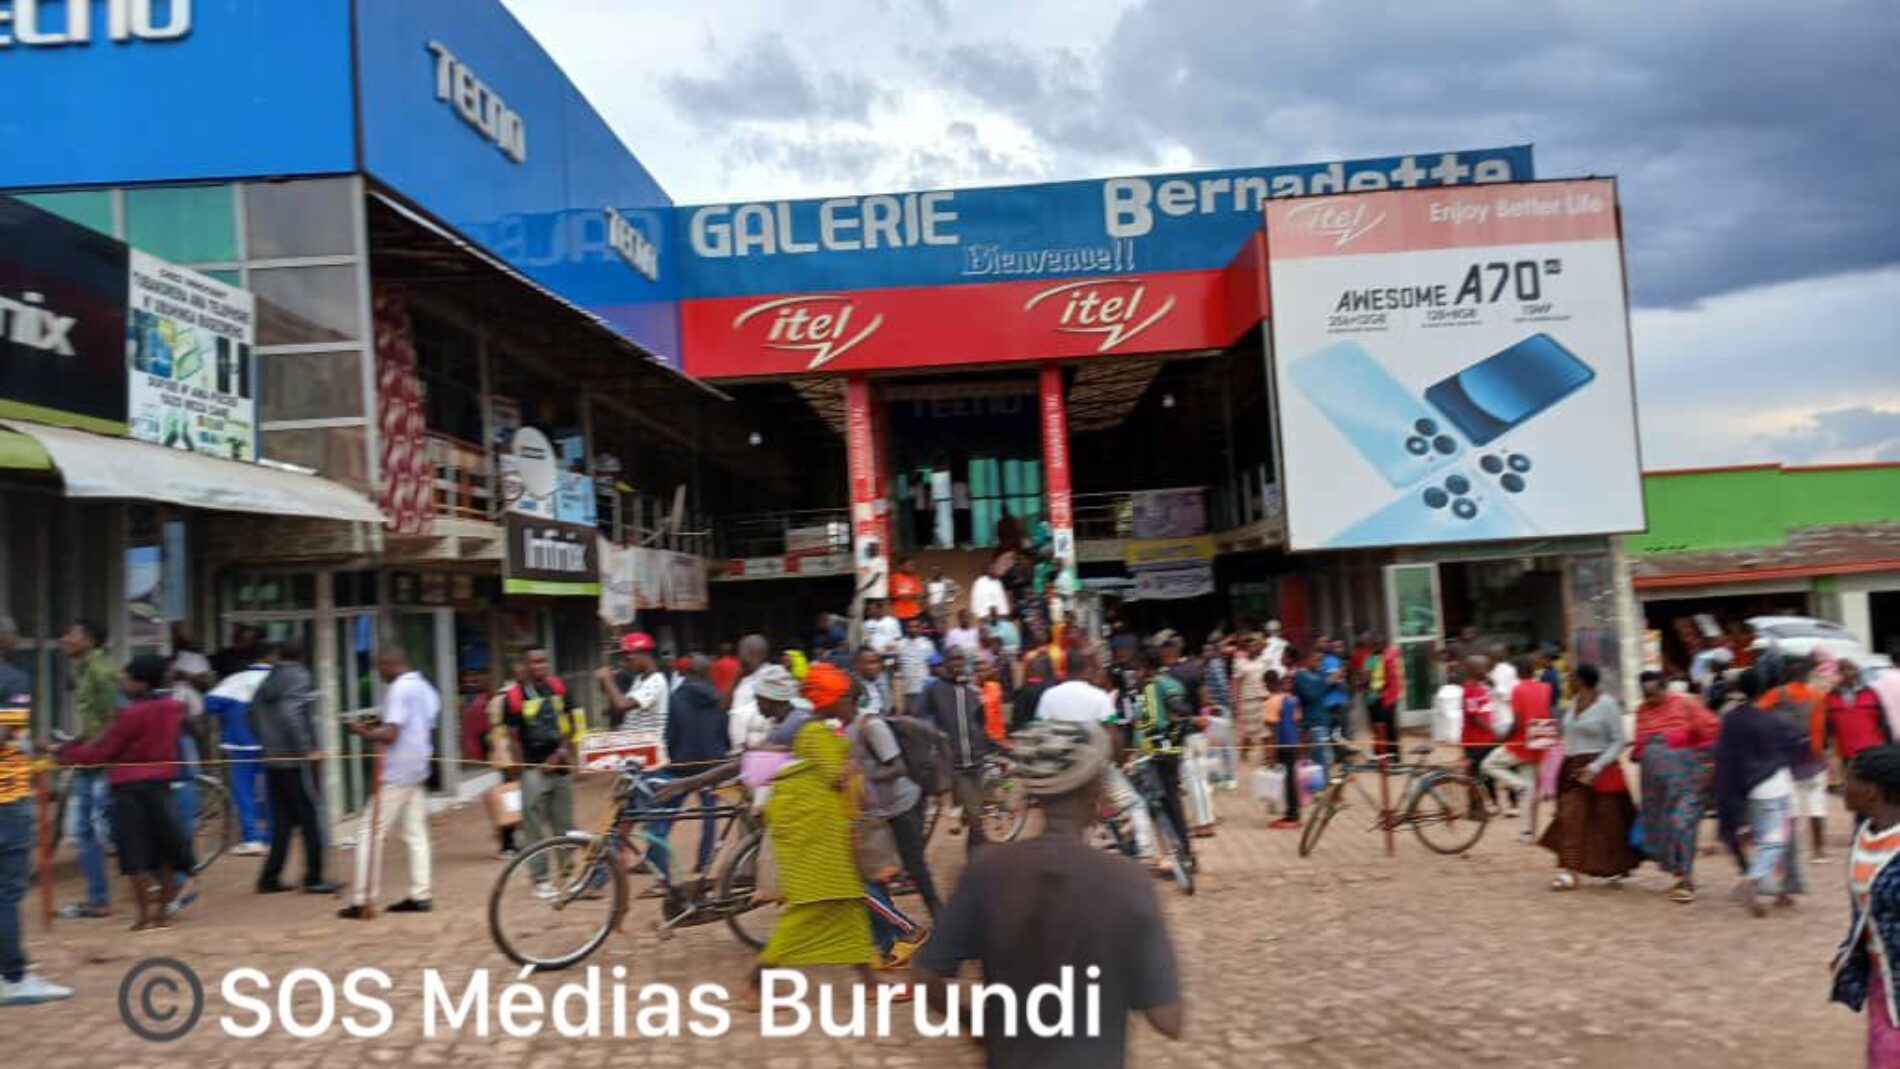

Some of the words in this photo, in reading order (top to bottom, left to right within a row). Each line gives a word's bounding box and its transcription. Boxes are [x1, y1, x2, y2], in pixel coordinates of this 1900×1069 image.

[0, 0, 192, 45] CNO
[427, 40, 526, 163] TECNO
[689, 191, 961, 259] GALERIE
[1430, 201, 1490, 225] Enjoy
[1495, 196, 1561, 218] Better
[1565, 192, 1603, 214] Life
[1059, 286, 1146, 325] itel
[1335, 285, 1447, 313] AWESOME
[1453, 260, 1541, 305] A70
[765, 304, 854, 342] itel
